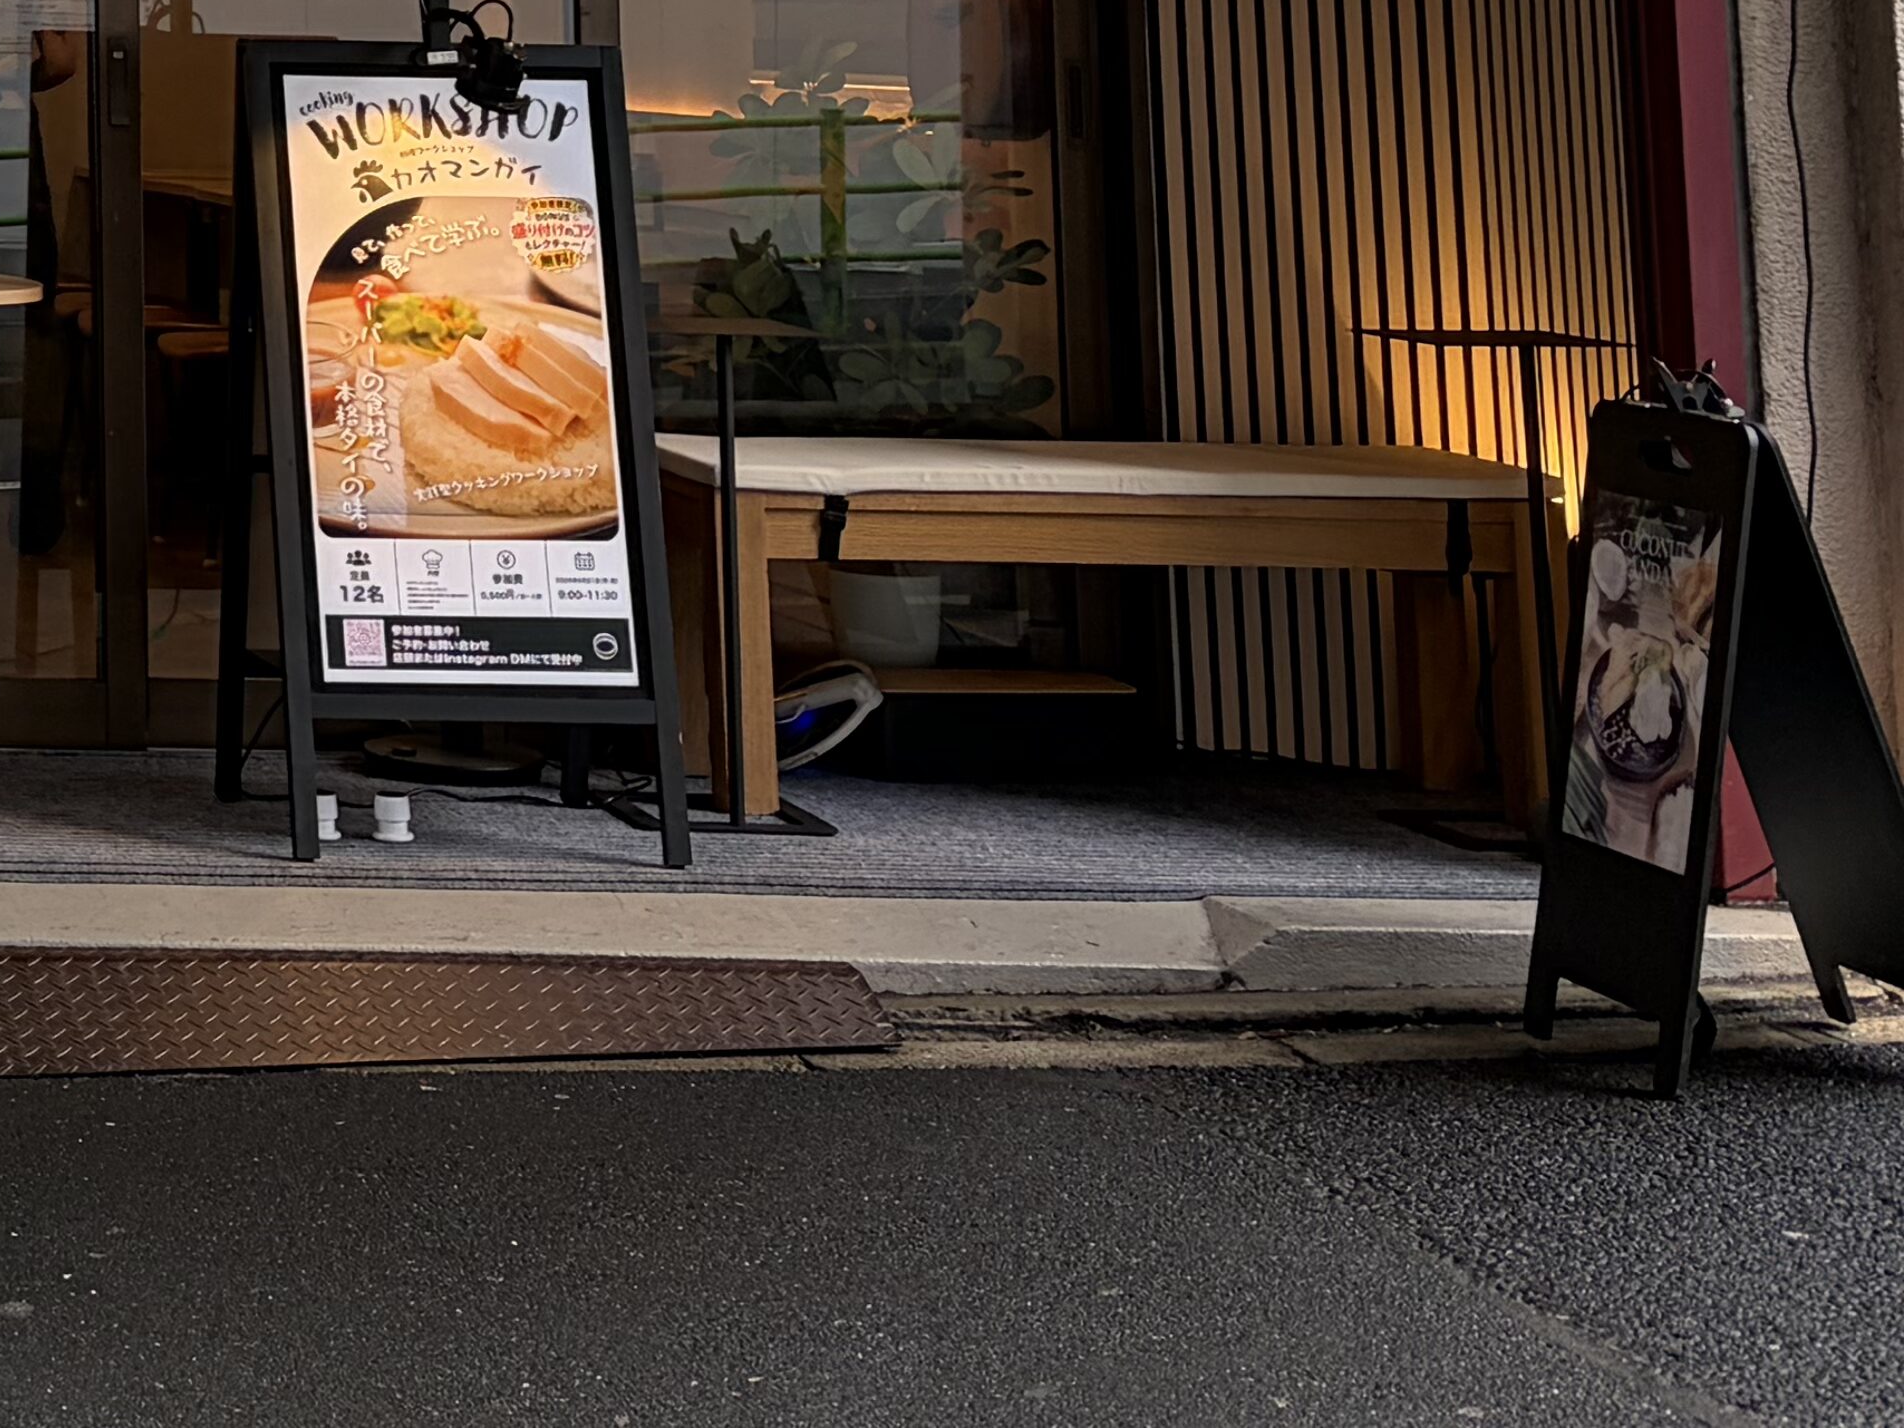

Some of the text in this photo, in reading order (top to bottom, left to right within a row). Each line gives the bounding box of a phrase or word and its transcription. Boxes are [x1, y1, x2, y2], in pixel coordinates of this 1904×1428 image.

[305, 92, 580, 160] WORKSHOP
[391, 155, 543, 191] カオマンガイ
[339, 584, 385, 604] 12名
